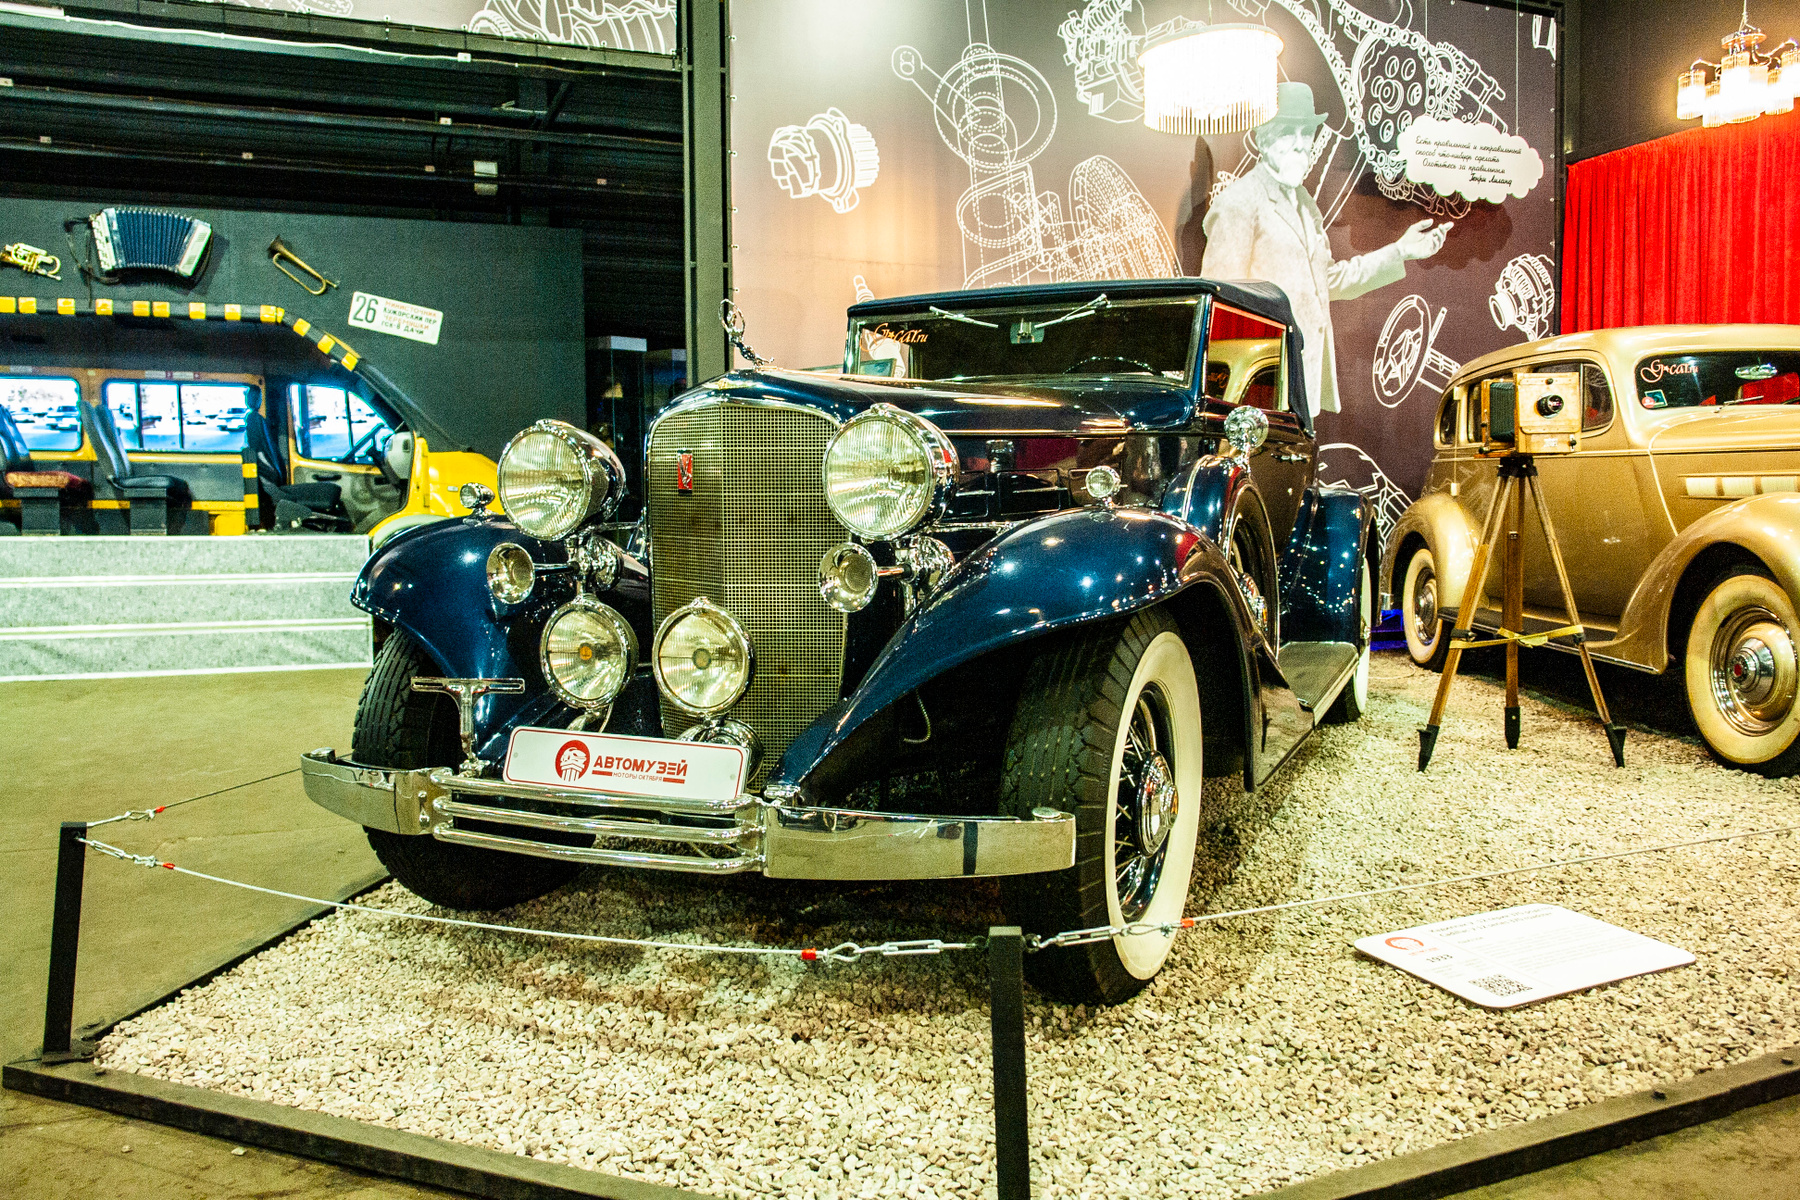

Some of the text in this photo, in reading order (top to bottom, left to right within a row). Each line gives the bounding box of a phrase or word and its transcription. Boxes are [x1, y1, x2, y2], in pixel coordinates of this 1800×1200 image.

[1415, 135, 1432, 145] Есть
[1415, 148, 1436, 157] способ
[352, 296, 378, 323] 26
[593, 755, 688, 777] АВТОМУЗЕЙ
[613, 772, 638, 780] МОТОРЫ
